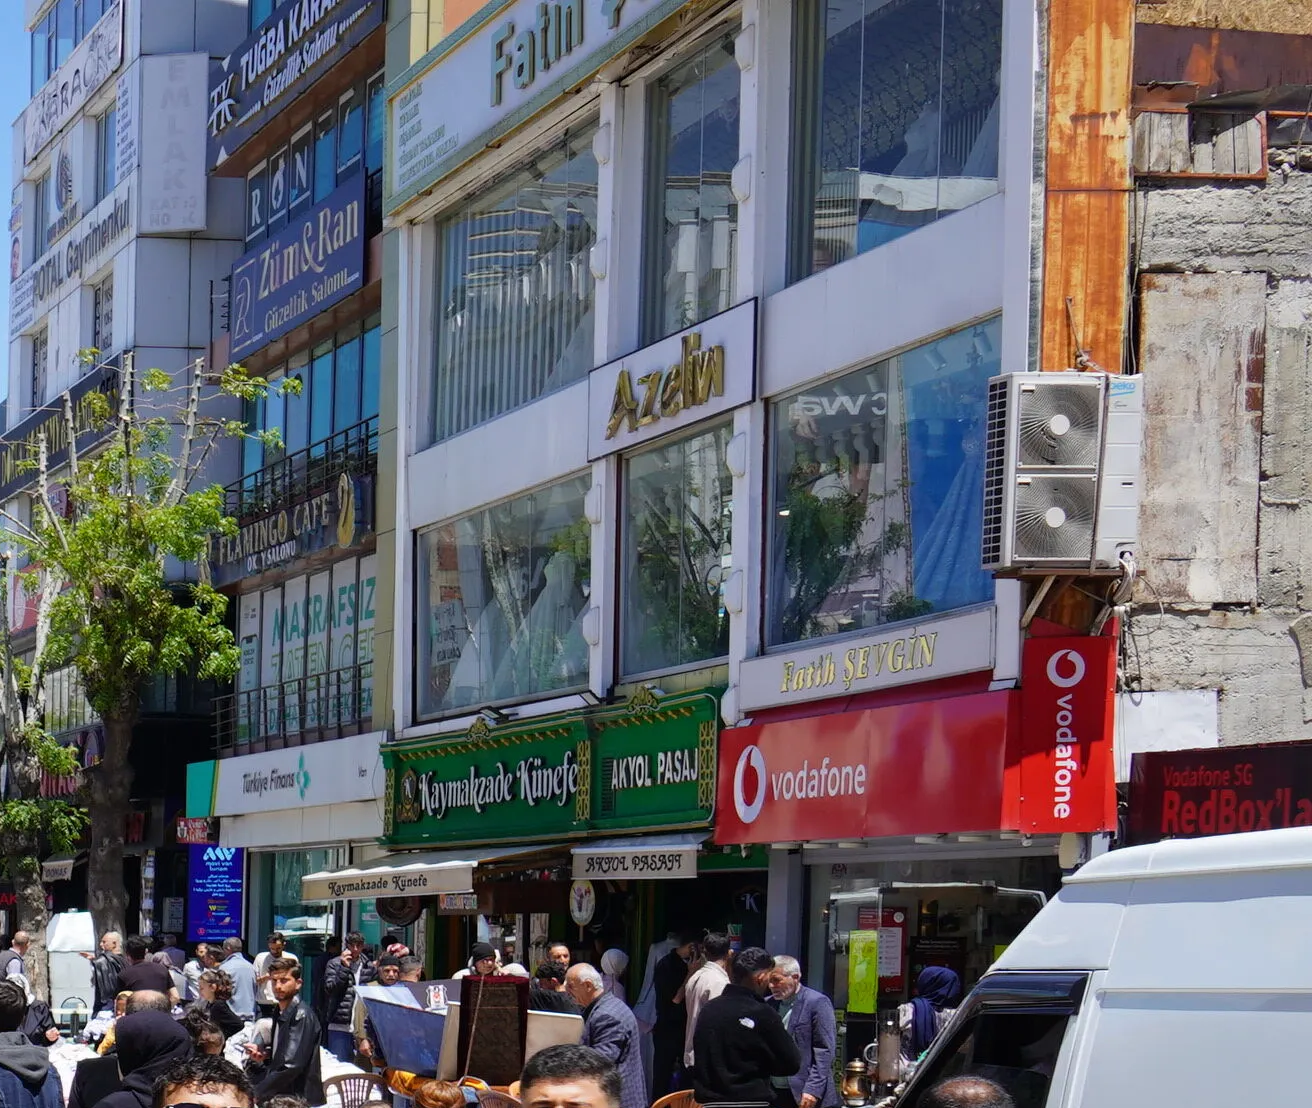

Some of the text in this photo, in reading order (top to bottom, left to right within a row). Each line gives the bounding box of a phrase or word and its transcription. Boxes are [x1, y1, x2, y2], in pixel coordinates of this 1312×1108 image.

[240, 19, 286, 91] TUĞBA
[293, 492, 329, 536] CAFE
[780, 652, 836, 694] Fatih
[611, 748, 699, 790] AKYOL PASAJ
[1053, 694, 1078, 819] vodafone
[1163, 763, 1253, 787] Vodafone 5G
[242, 768, 295, 798] Türkiye Finans
[418, 749, 578, 820] Kaymakzade Künefe
[772, 757, 866, 802] vodafone
[586, 856, 629, 873] AKYOL
[328, 876, 389, 897] Kaymakzade
